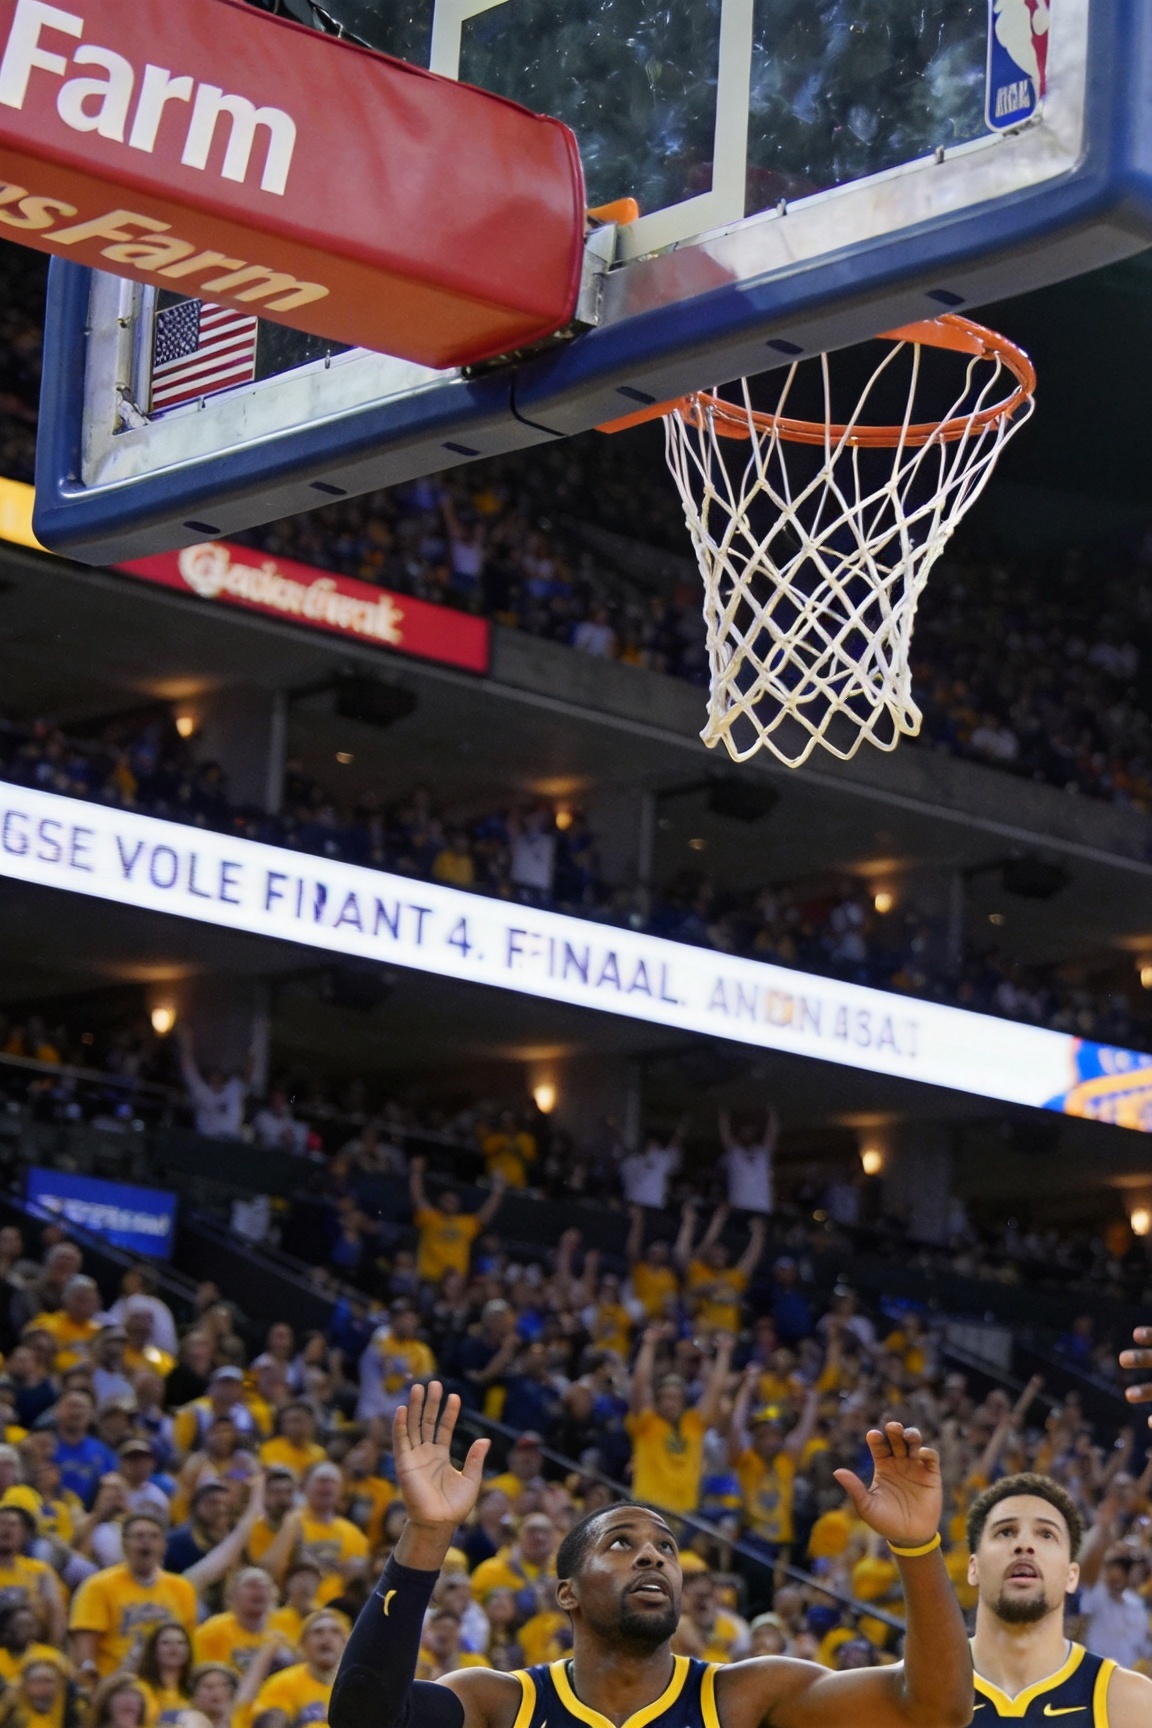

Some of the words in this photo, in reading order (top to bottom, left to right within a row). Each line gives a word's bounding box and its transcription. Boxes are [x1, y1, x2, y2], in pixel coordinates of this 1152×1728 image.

[0, 0, 298, 197] Farm
[41, 209, 330, 312] Farm
[115, 834, 244, 906] VOLE
